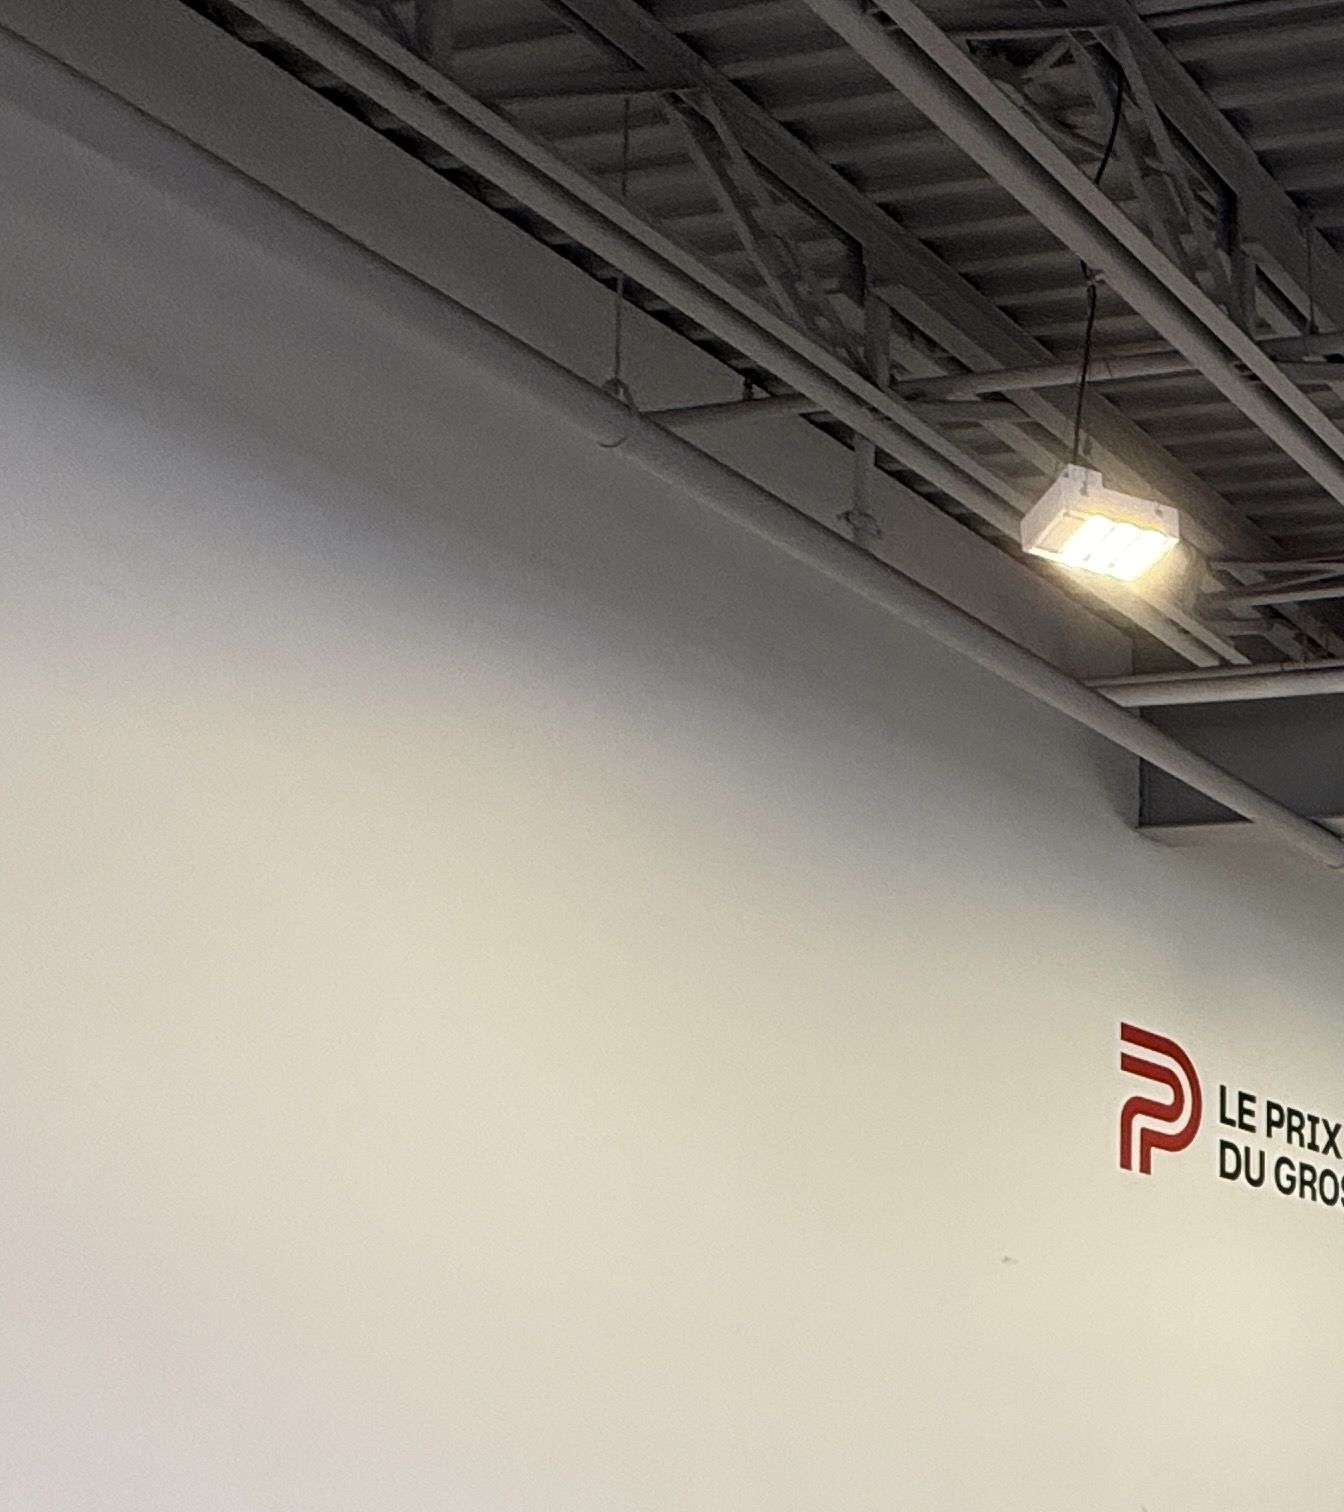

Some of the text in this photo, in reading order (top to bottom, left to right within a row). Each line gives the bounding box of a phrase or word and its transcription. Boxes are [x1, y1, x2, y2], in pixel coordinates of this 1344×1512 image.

[1219, 1084, 1342, 1159] LE PRIX
[1219, 1139, 1265, 1187] DU
